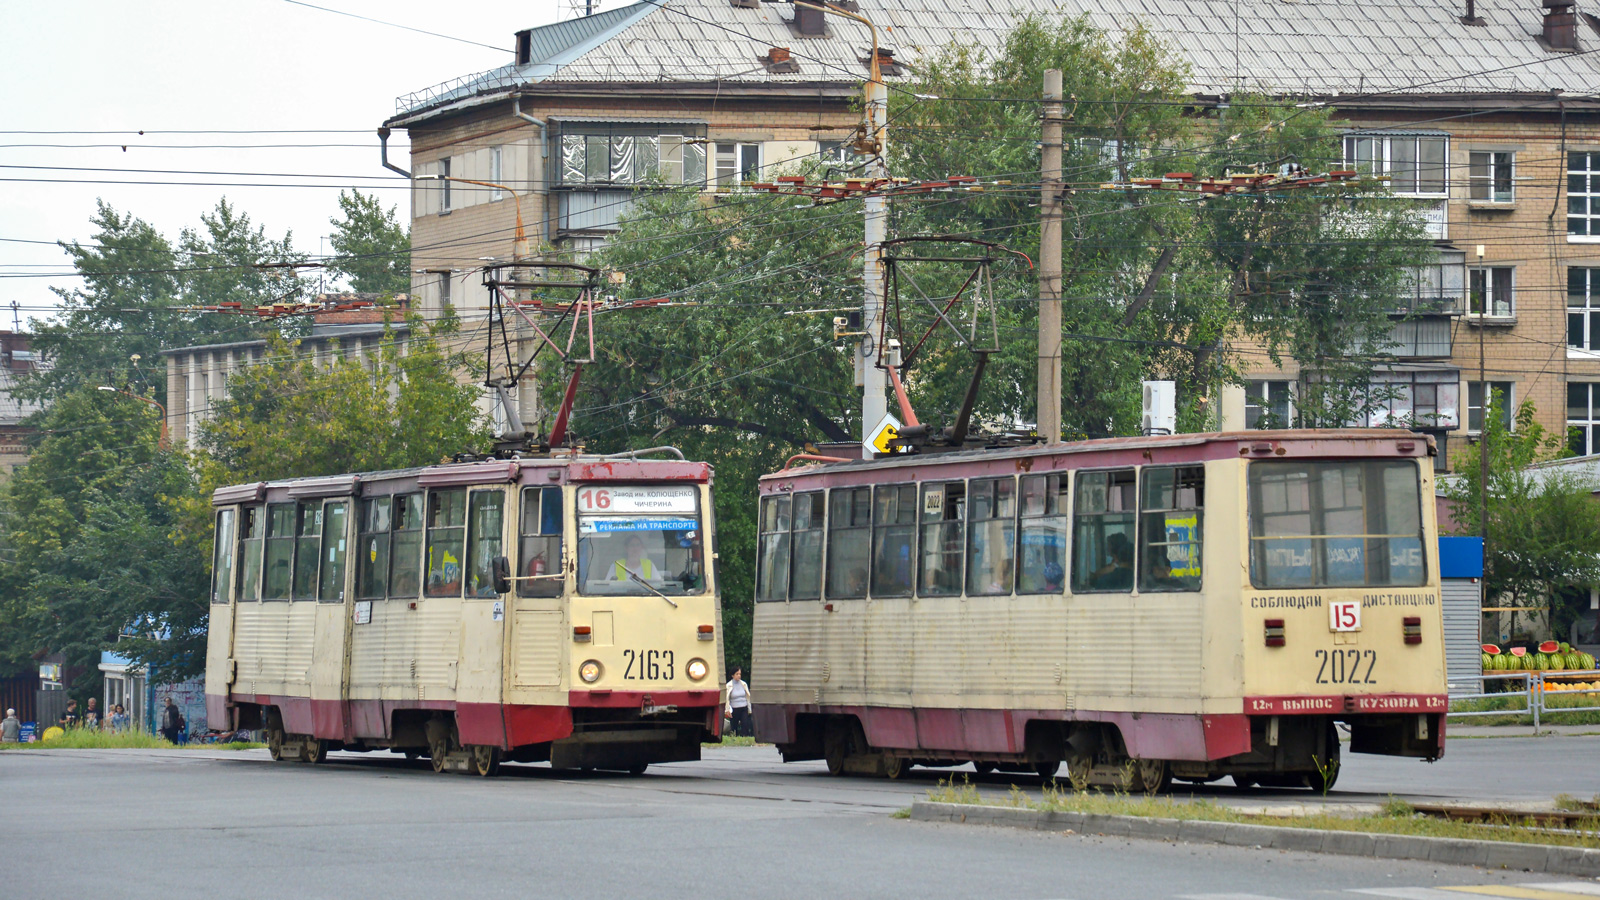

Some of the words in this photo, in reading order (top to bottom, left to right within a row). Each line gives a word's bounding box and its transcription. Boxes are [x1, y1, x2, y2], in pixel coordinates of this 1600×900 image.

[581, 489, 611, 509] 16
[613, 490, 633, 498] Завод
[647, 490, 693, 498] КОЛЮЩЕНКО
[927, 495, 940, 508] 2022
[600, 522, 636, 531] РЕКЛАМА
[637, 522, 647, 530] НА
[649, 521, 697, 530] ТРАНСПОРТЕ
[1251, 594, 1322, 609] СОБЛЮДАЙ
[1362, 594, 1435, 608] ДИСТАНЦИЮ
[1335, 604, 1357, 628] 15
[623, 649, 674, 680] 2163
[1315, 649, 1377, 684] 2022
[1282, 698, 1333, 710] ВЫНОС
[1360, 697, 1420, 709] КУЗОВА
